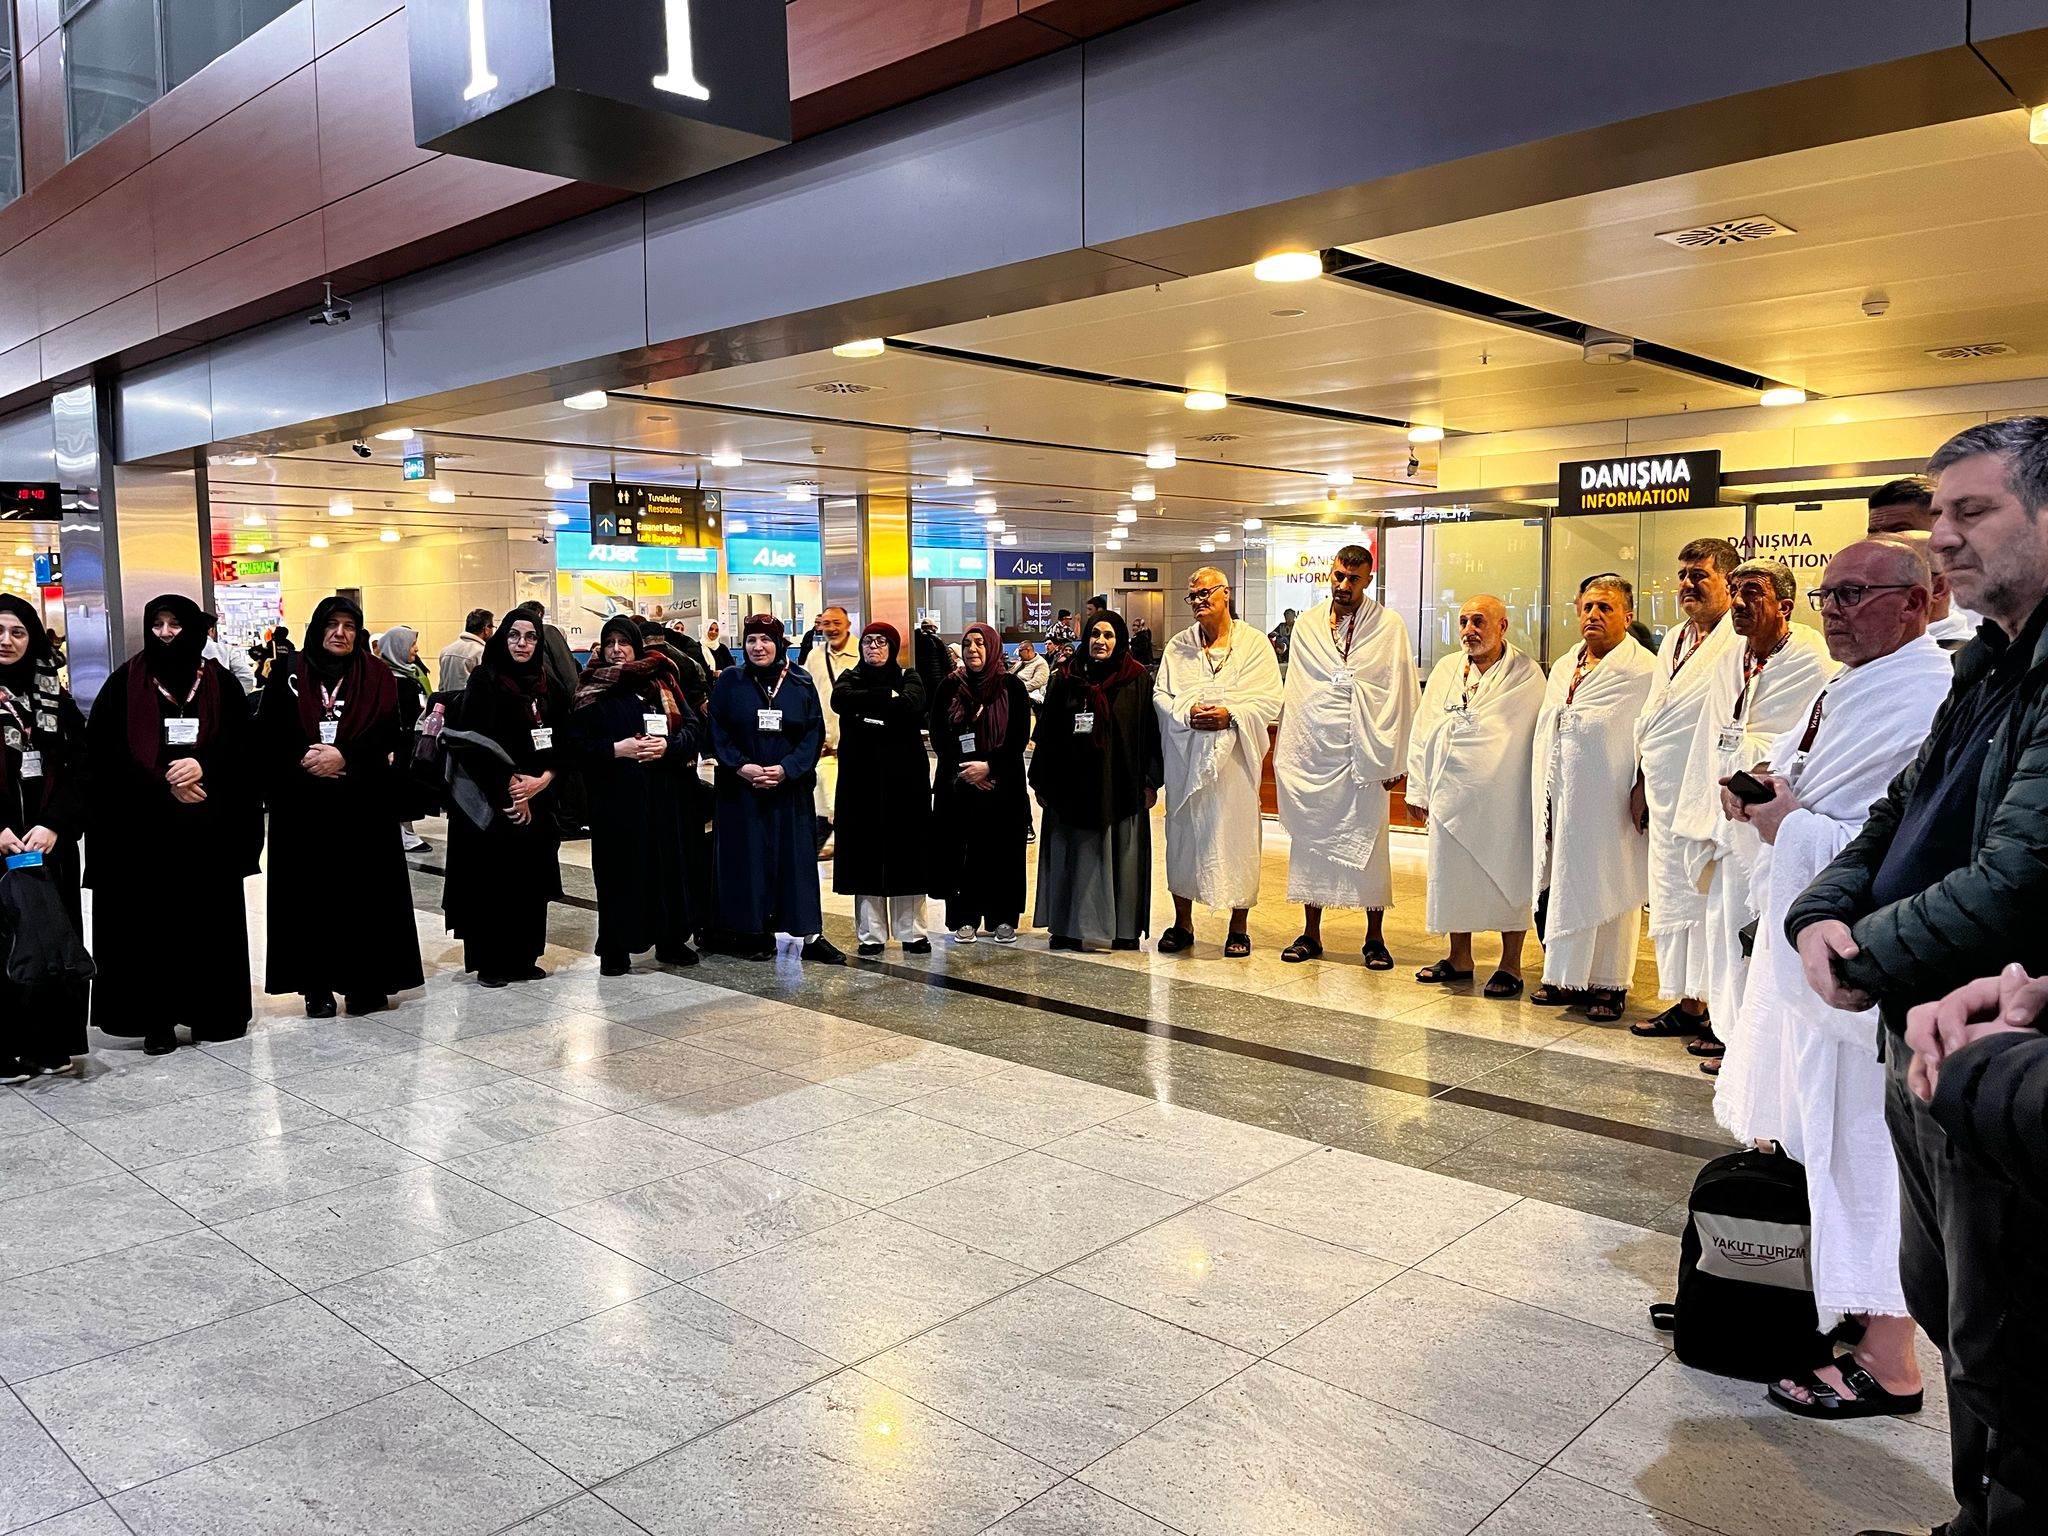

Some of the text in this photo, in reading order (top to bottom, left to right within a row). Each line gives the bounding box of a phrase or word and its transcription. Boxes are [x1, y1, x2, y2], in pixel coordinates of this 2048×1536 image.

[1580, 458, 1690, 490] DANIŞMA
[648, 493, 681, 503] Tuvaletler
[1581, 487, 1690, 509] INFORMATION
[648, 504, 682, 514] Restrooms
[637, 522, 663, 532] Emanet
[637, 533, 681, 545] Left Baggage
[1727, 533, 1812, 551] DANIŞMA
[753, 547, 796, 568] AJet
[1012, 558, 1043, 574] AJet
[1712, 1236, 1755, 1253] YAKUT
[1757, 1244, 1806, 1259] TURİZM
